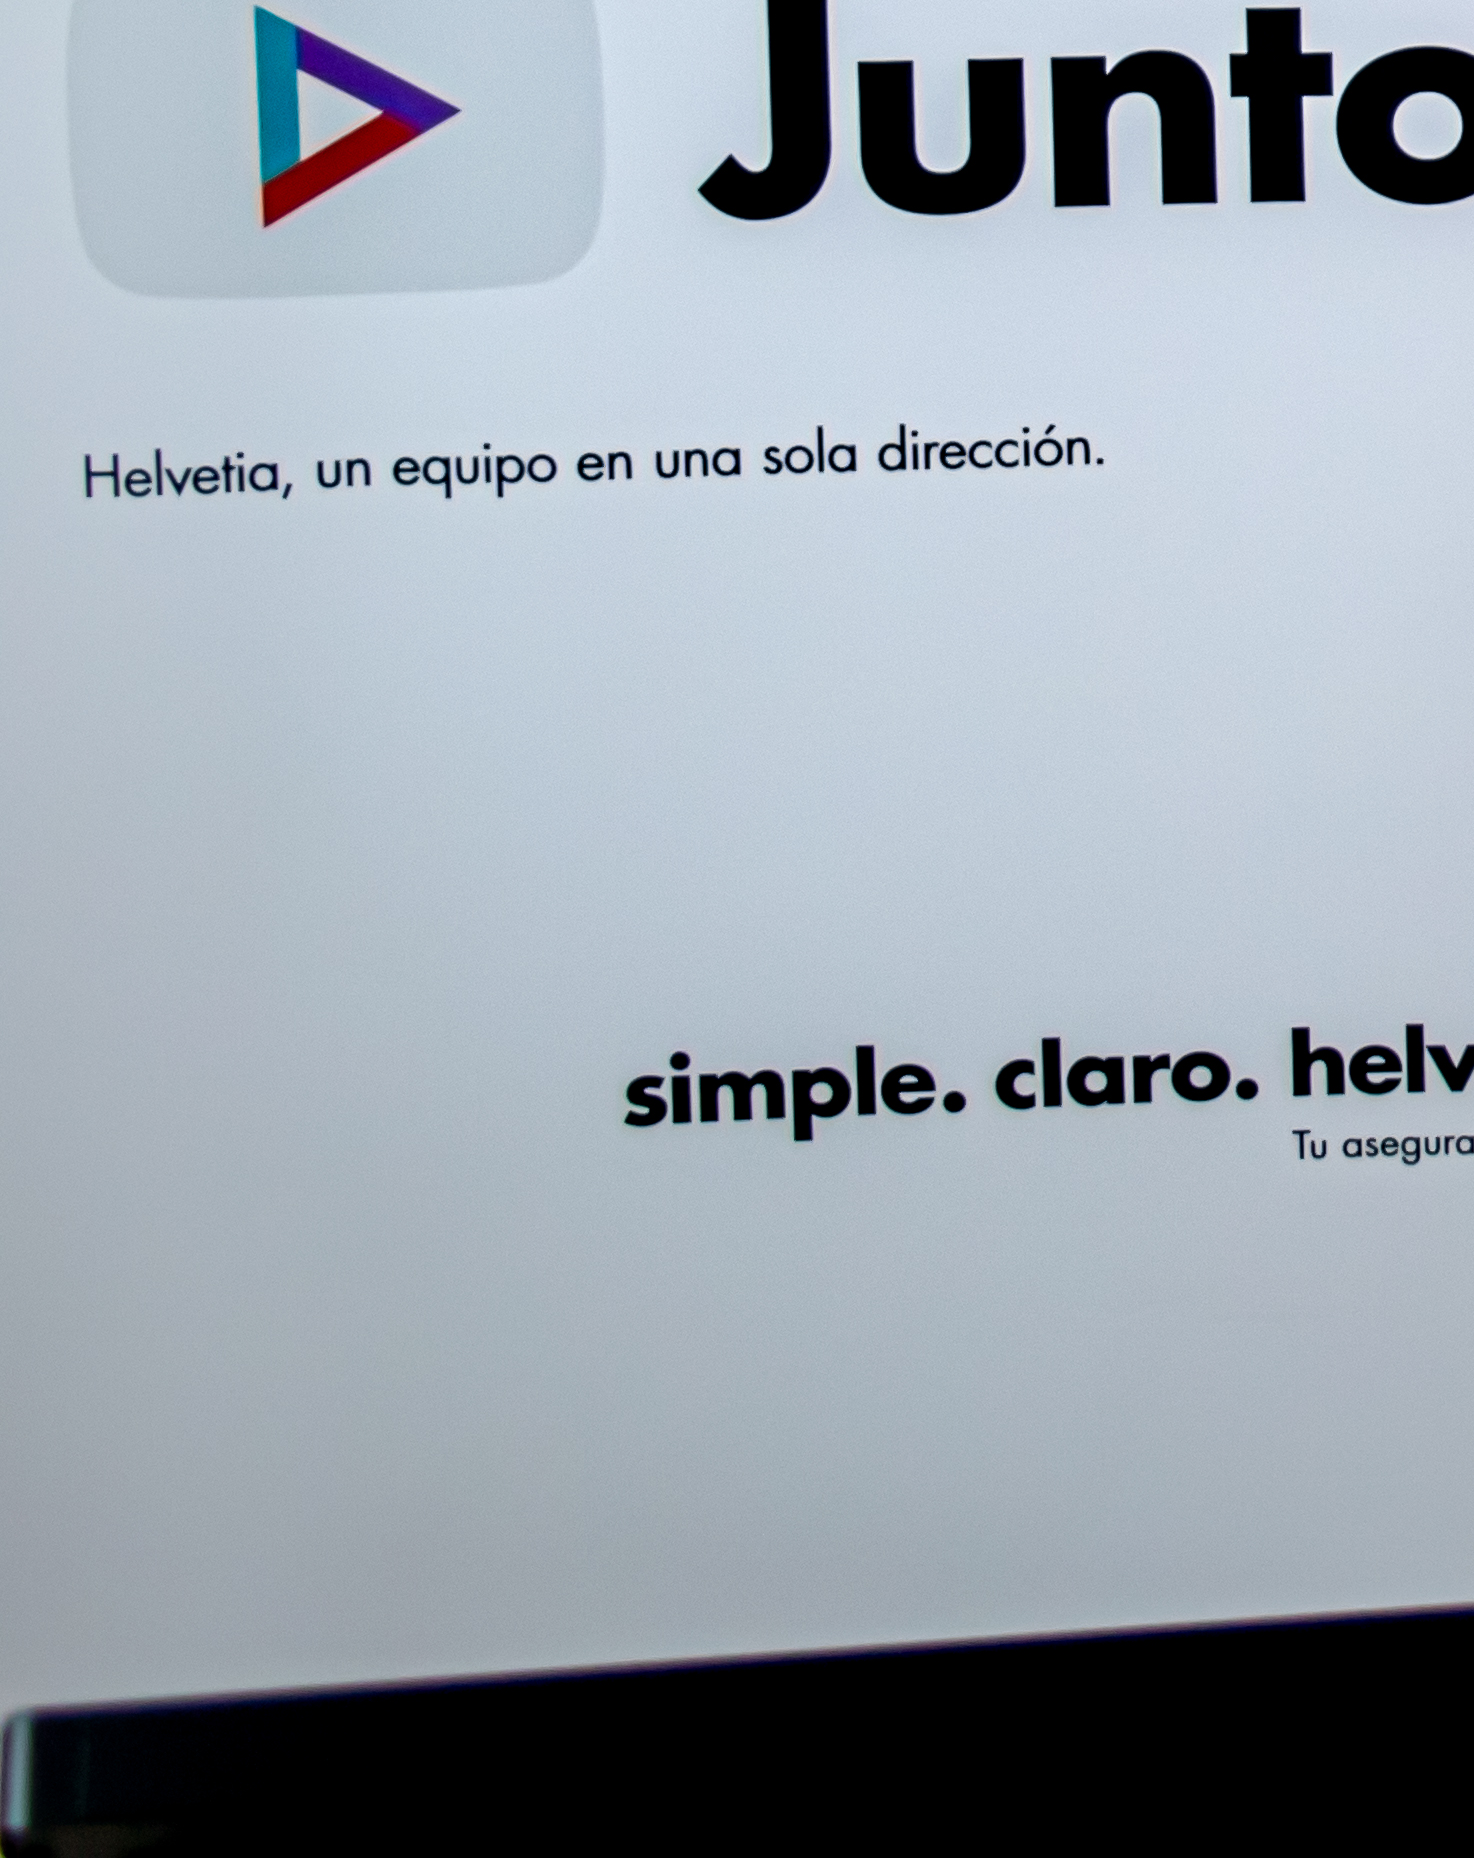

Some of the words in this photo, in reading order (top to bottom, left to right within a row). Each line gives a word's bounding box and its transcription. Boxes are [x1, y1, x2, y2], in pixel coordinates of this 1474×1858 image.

[84, 448, 293, 500] Helvetia,
[316, 457, 371, 489] un
[392, 442, 558, 499] equipo
[576, 451, 633, 482] en
[655, 447, 741, 479] una
[762, 425, 857, 475] sola
[877, 423, 1104, 472] dirección.
[623, 1044, 967, 1143] simple.
[994, 1036, 1259, 1111] claro.
[1291, 1129, 1327, 1160] Tu
